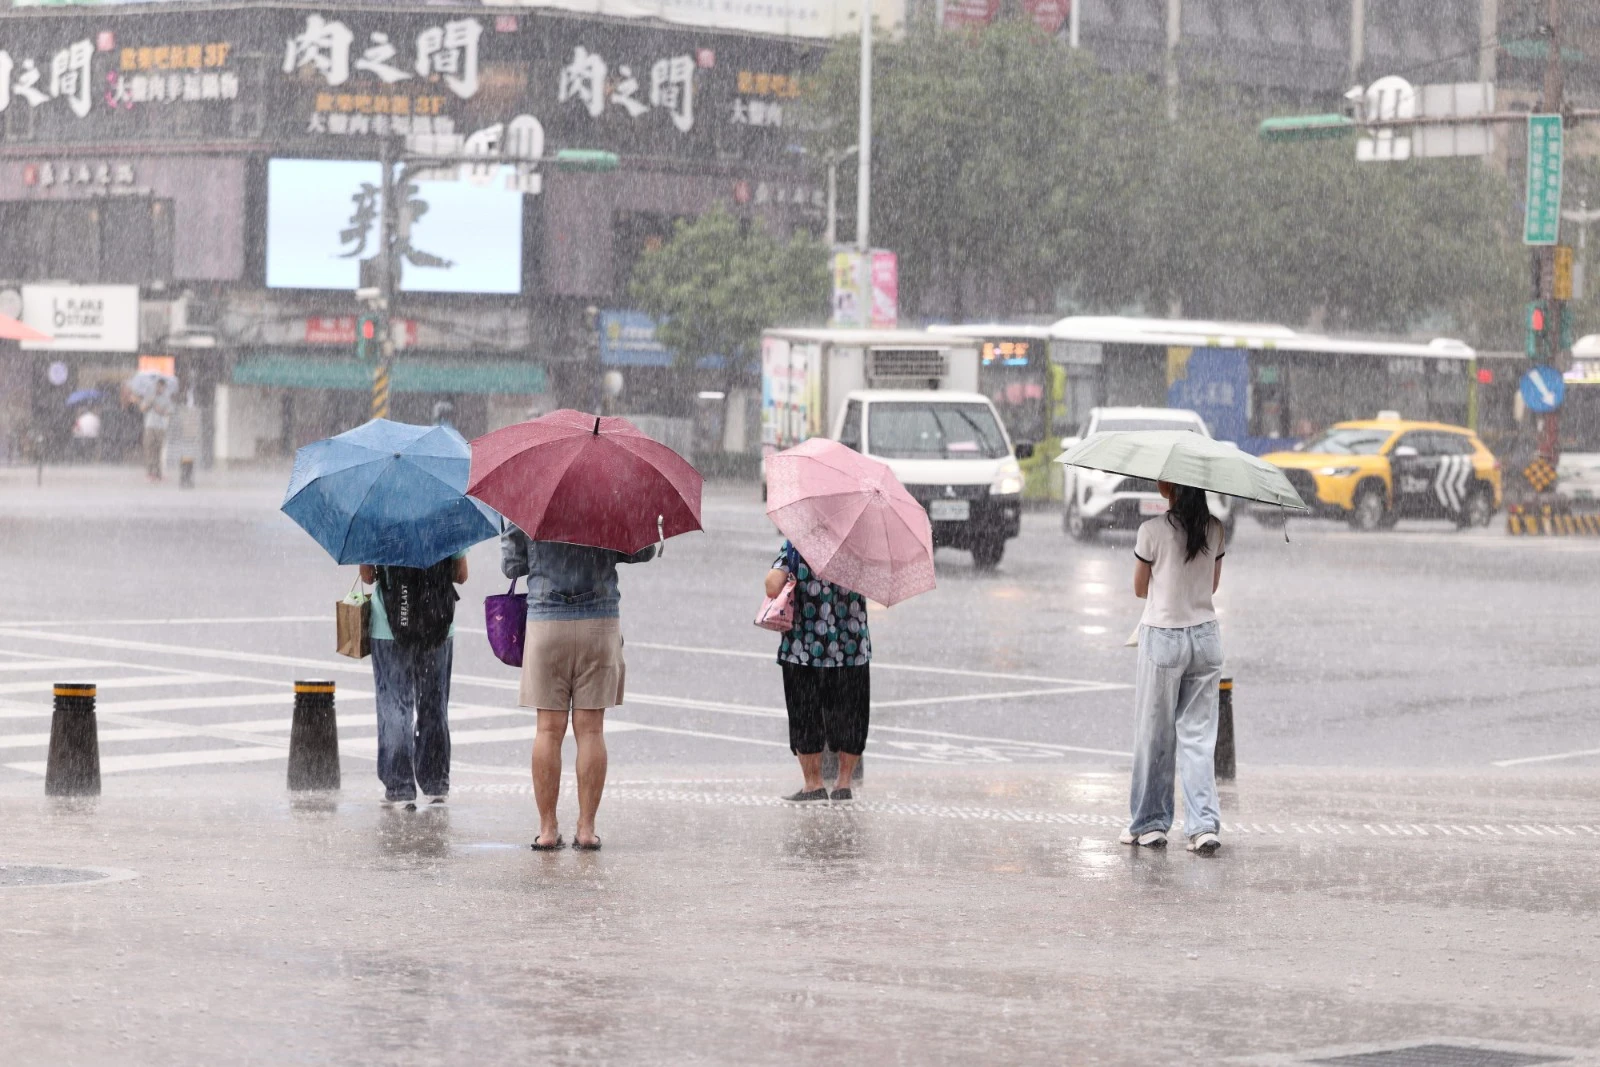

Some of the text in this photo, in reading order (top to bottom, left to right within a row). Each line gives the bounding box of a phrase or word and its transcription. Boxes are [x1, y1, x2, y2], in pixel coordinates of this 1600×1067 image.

[0, 38, 95, 119] 之間
[282, 13, 484, 99] 肉之間
[557, 45, 695, 132] 肉之間
